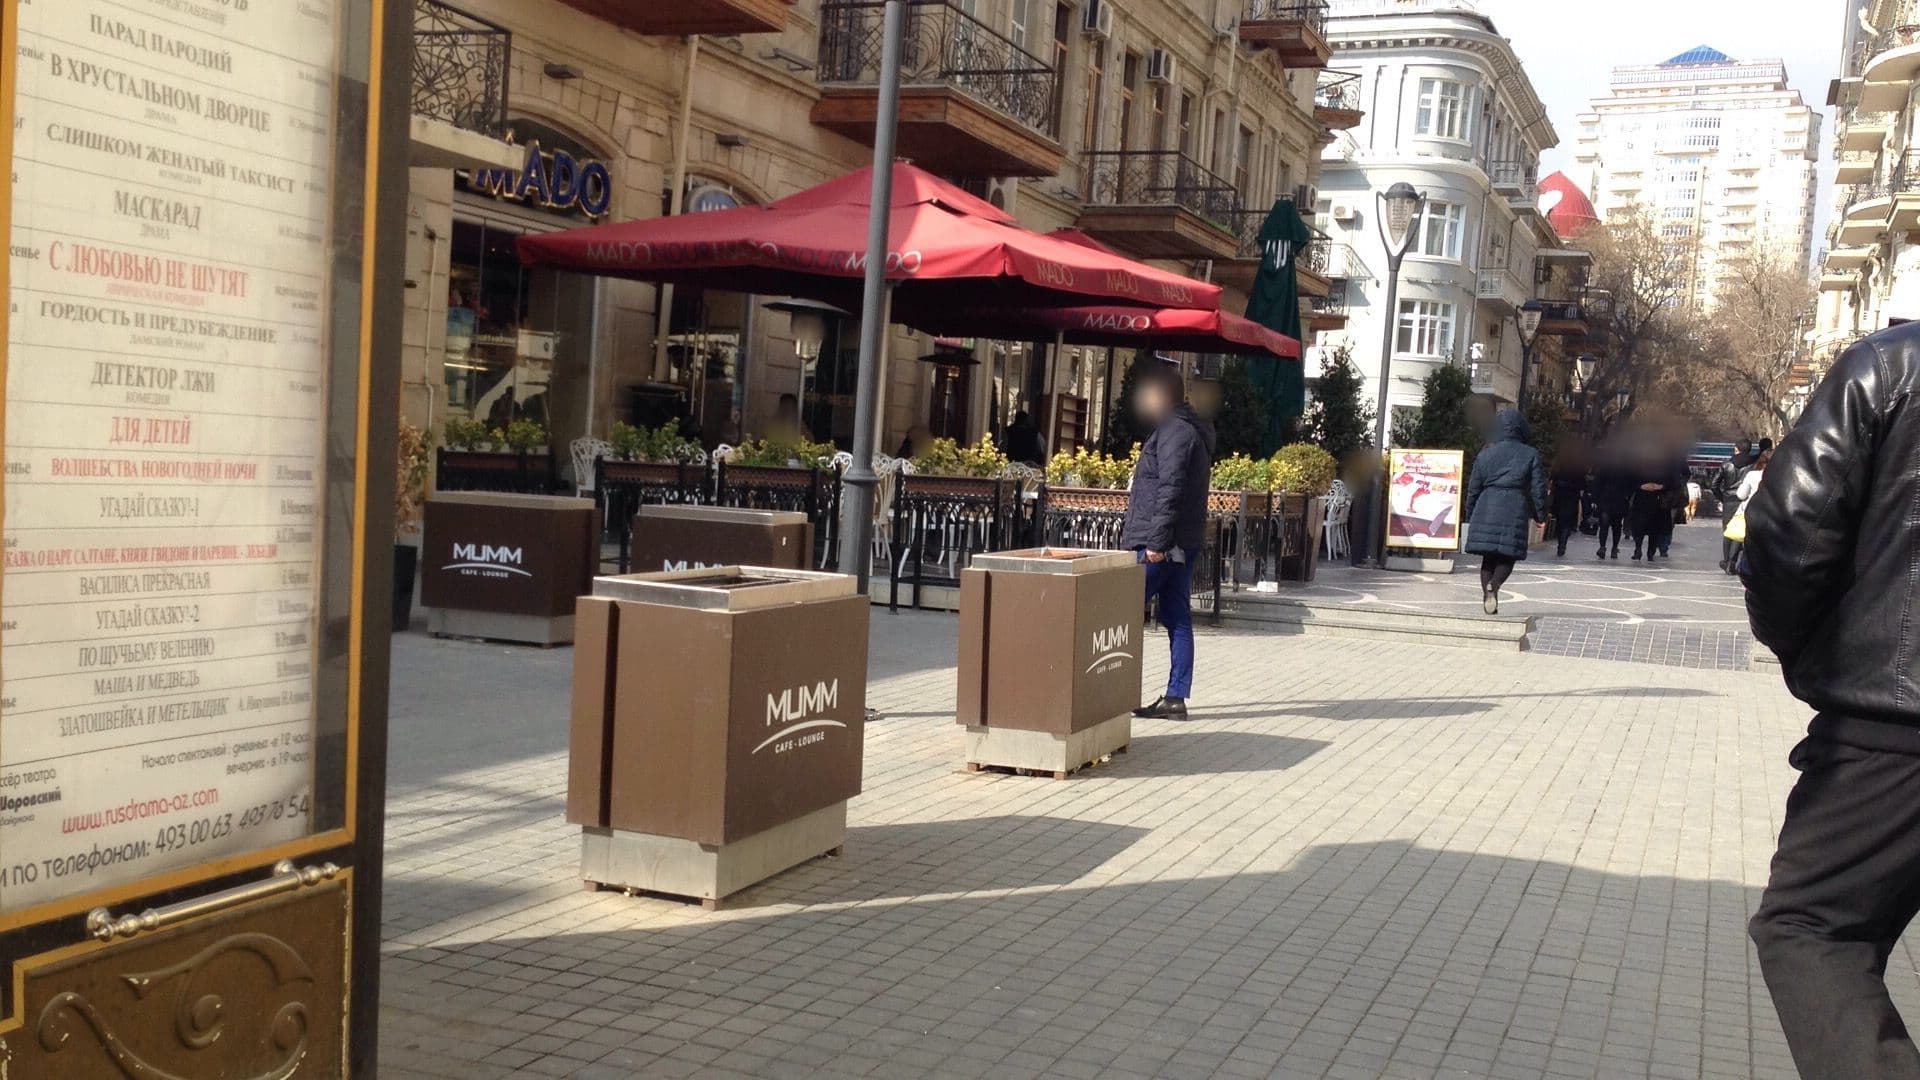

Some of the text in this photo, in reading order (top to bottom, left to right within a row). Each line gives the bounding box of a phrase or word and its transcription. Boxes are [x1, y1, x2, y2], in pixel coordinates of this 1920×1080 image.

[90, 14, 232, 74] ПАРАД ПАРОДИЙ
[51, 53, 62, 76] В
[67, 58, 200, 115] ХРУСТАЛЬНОМ
[204, 98, 270, 132] ДВОРЦЕ
[144, 108, 177, 125] ДРАМА
[47, 123, 295, 194] СЛИШКОМ ЖЕНАТЫЙ ТАКСИСТ
[114, 190, 201, 231] МАСКАРАД
[141, 223, 170, 240] ДРАМА
[587, 242, 650, 264] MADO
[845, 250, 922, 274] MDO
[50, 240, 62, 271] С
[66, 244, 161, 285] ЛЮБОВЬЮ
[166, 259, 186, 288] НЕ
[192, 263, 249, 297] ШУТЯТ
[1036, 261, 1194, 304] MADO MADO MADO
[40, 300, 130, 326] ГОРДОСТЬ
[135, 312, 145, 328] И
[150, 314, 277, 344] ПРЕДУБЕЖДЕНИЕ
[1083, 312, 1151, 332] MADO
[91, 361, 215, 393] ДЕТЕКТОР ЛЖИ
[110, 415, 190, 445] ДЛЯ ДЕТЕЙ
[51, 457, 137, 478] ВОЛШЕБСТВА
[142, 458, 221, 481] НОВОГОДНЕЙ
[224, 462, 256, 480] НОЧИ
[100, 492, 145, 519] УГАДАЙ
[38, 550, 45, 566] О
[47, 549, 72, 566] ЦАРЕ
[121, 546, 149, 563] КНЯЗЕ
[453, 542, 523, 564] MUMM
[80, 571, 210, 596] ВАСИЛИСА ПРЕКРАСНАЯ
[96, 604, 142, 630] УГАДАЙ
[78, 637, 214, 667] ПО ЩУЧЬЕМУ ВЕЛЕНИЮ
[1092, 623, 1129, 656] MUMM
[94, 669, 199, 696] МАША И МЕДВЕДЬ
[766, 678, 838, 727] MUMM
[58, 704, 144, 737] ЗЛАТОШВЕЙКА
[147, 706, 156, 725] И
[158, 697, 229, 723] МЕТЕЛЬЩИК
[775, 739, 793, 754] CAFE
[798, 731, 825, 748] LOUNGE
[142, 752, 175, 769] Начало
[22, 767, 57, 784] театра
[62, 788, 219, 834] www.rusdrama-az.com
[13, 862, 38, 886] по
[43, 839, 150, 879] телефонам:
[155, 823, 186, 853] 493
[190, 818, 210, 846] 00
[287, 794, 310, 818] 54
